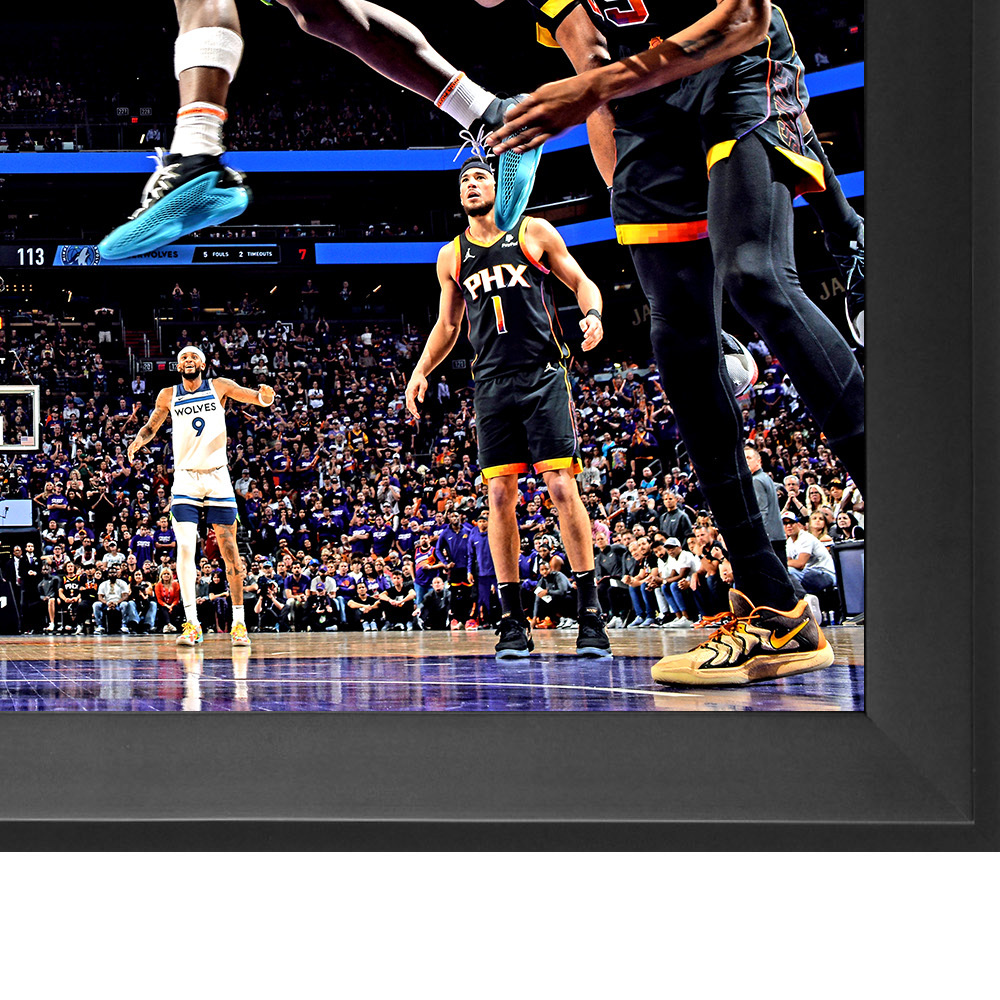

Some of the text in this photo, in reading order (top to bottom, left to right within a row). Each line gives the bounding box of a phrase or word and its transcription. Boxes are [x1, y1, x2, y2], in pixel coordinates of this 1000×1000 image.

[17, 248, 44, 266] 113
[298, 249, 307, 260] 7
[463, 264, 532, 300] PHX
[491, 295, 508, 335] 1
[174, 402, 217, 416] WOLVES
[192, 416, 206, 437] 9
